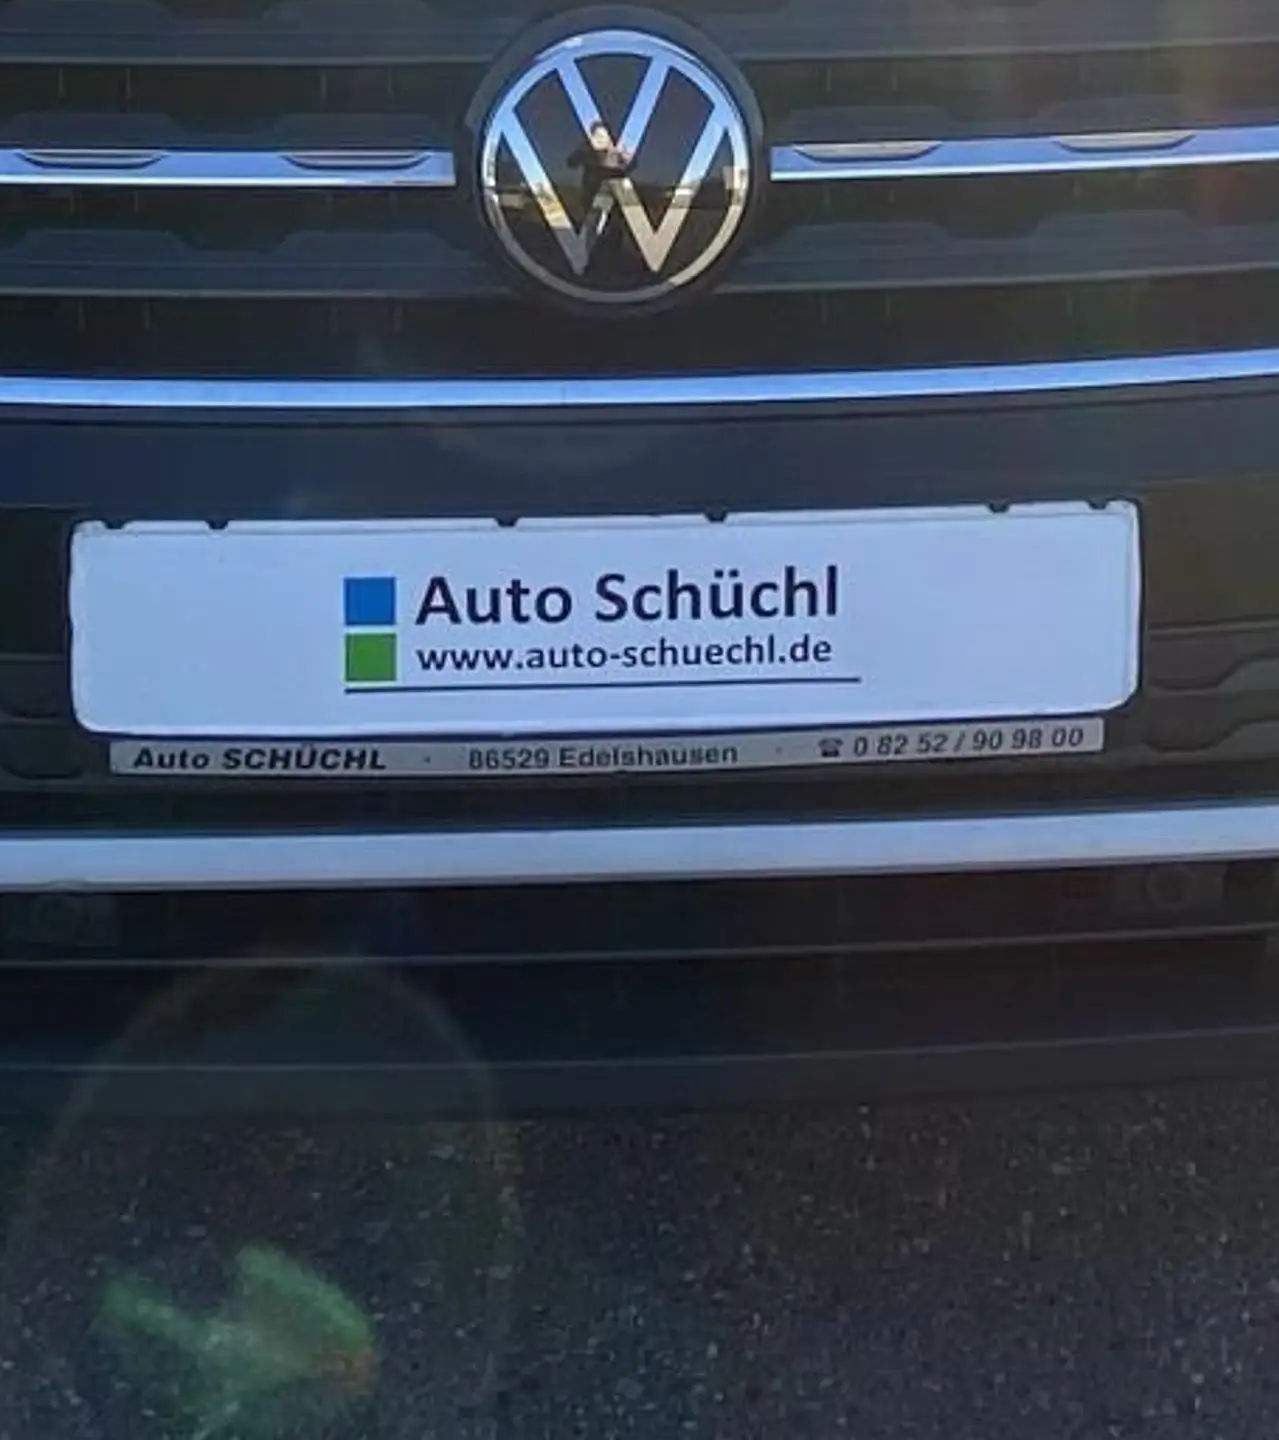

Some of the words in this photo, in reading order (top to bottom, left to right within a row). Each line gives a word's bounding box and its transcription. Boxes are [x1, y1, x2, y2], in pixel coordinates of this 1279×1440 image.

[415, 576, 572, 625] Auto
[595, 565, 838, 623] Schüchl
[416, 635, 832, 671] www.auto-schuechl.de
[132, 746, 210, 770] Auto
[222, 743, 387, 771] SCHÜCHL
[469, 748, 550, 771] 86529
[558, 743, 739, 767] Edelshausen
[853, 737, 868, 758] 0
